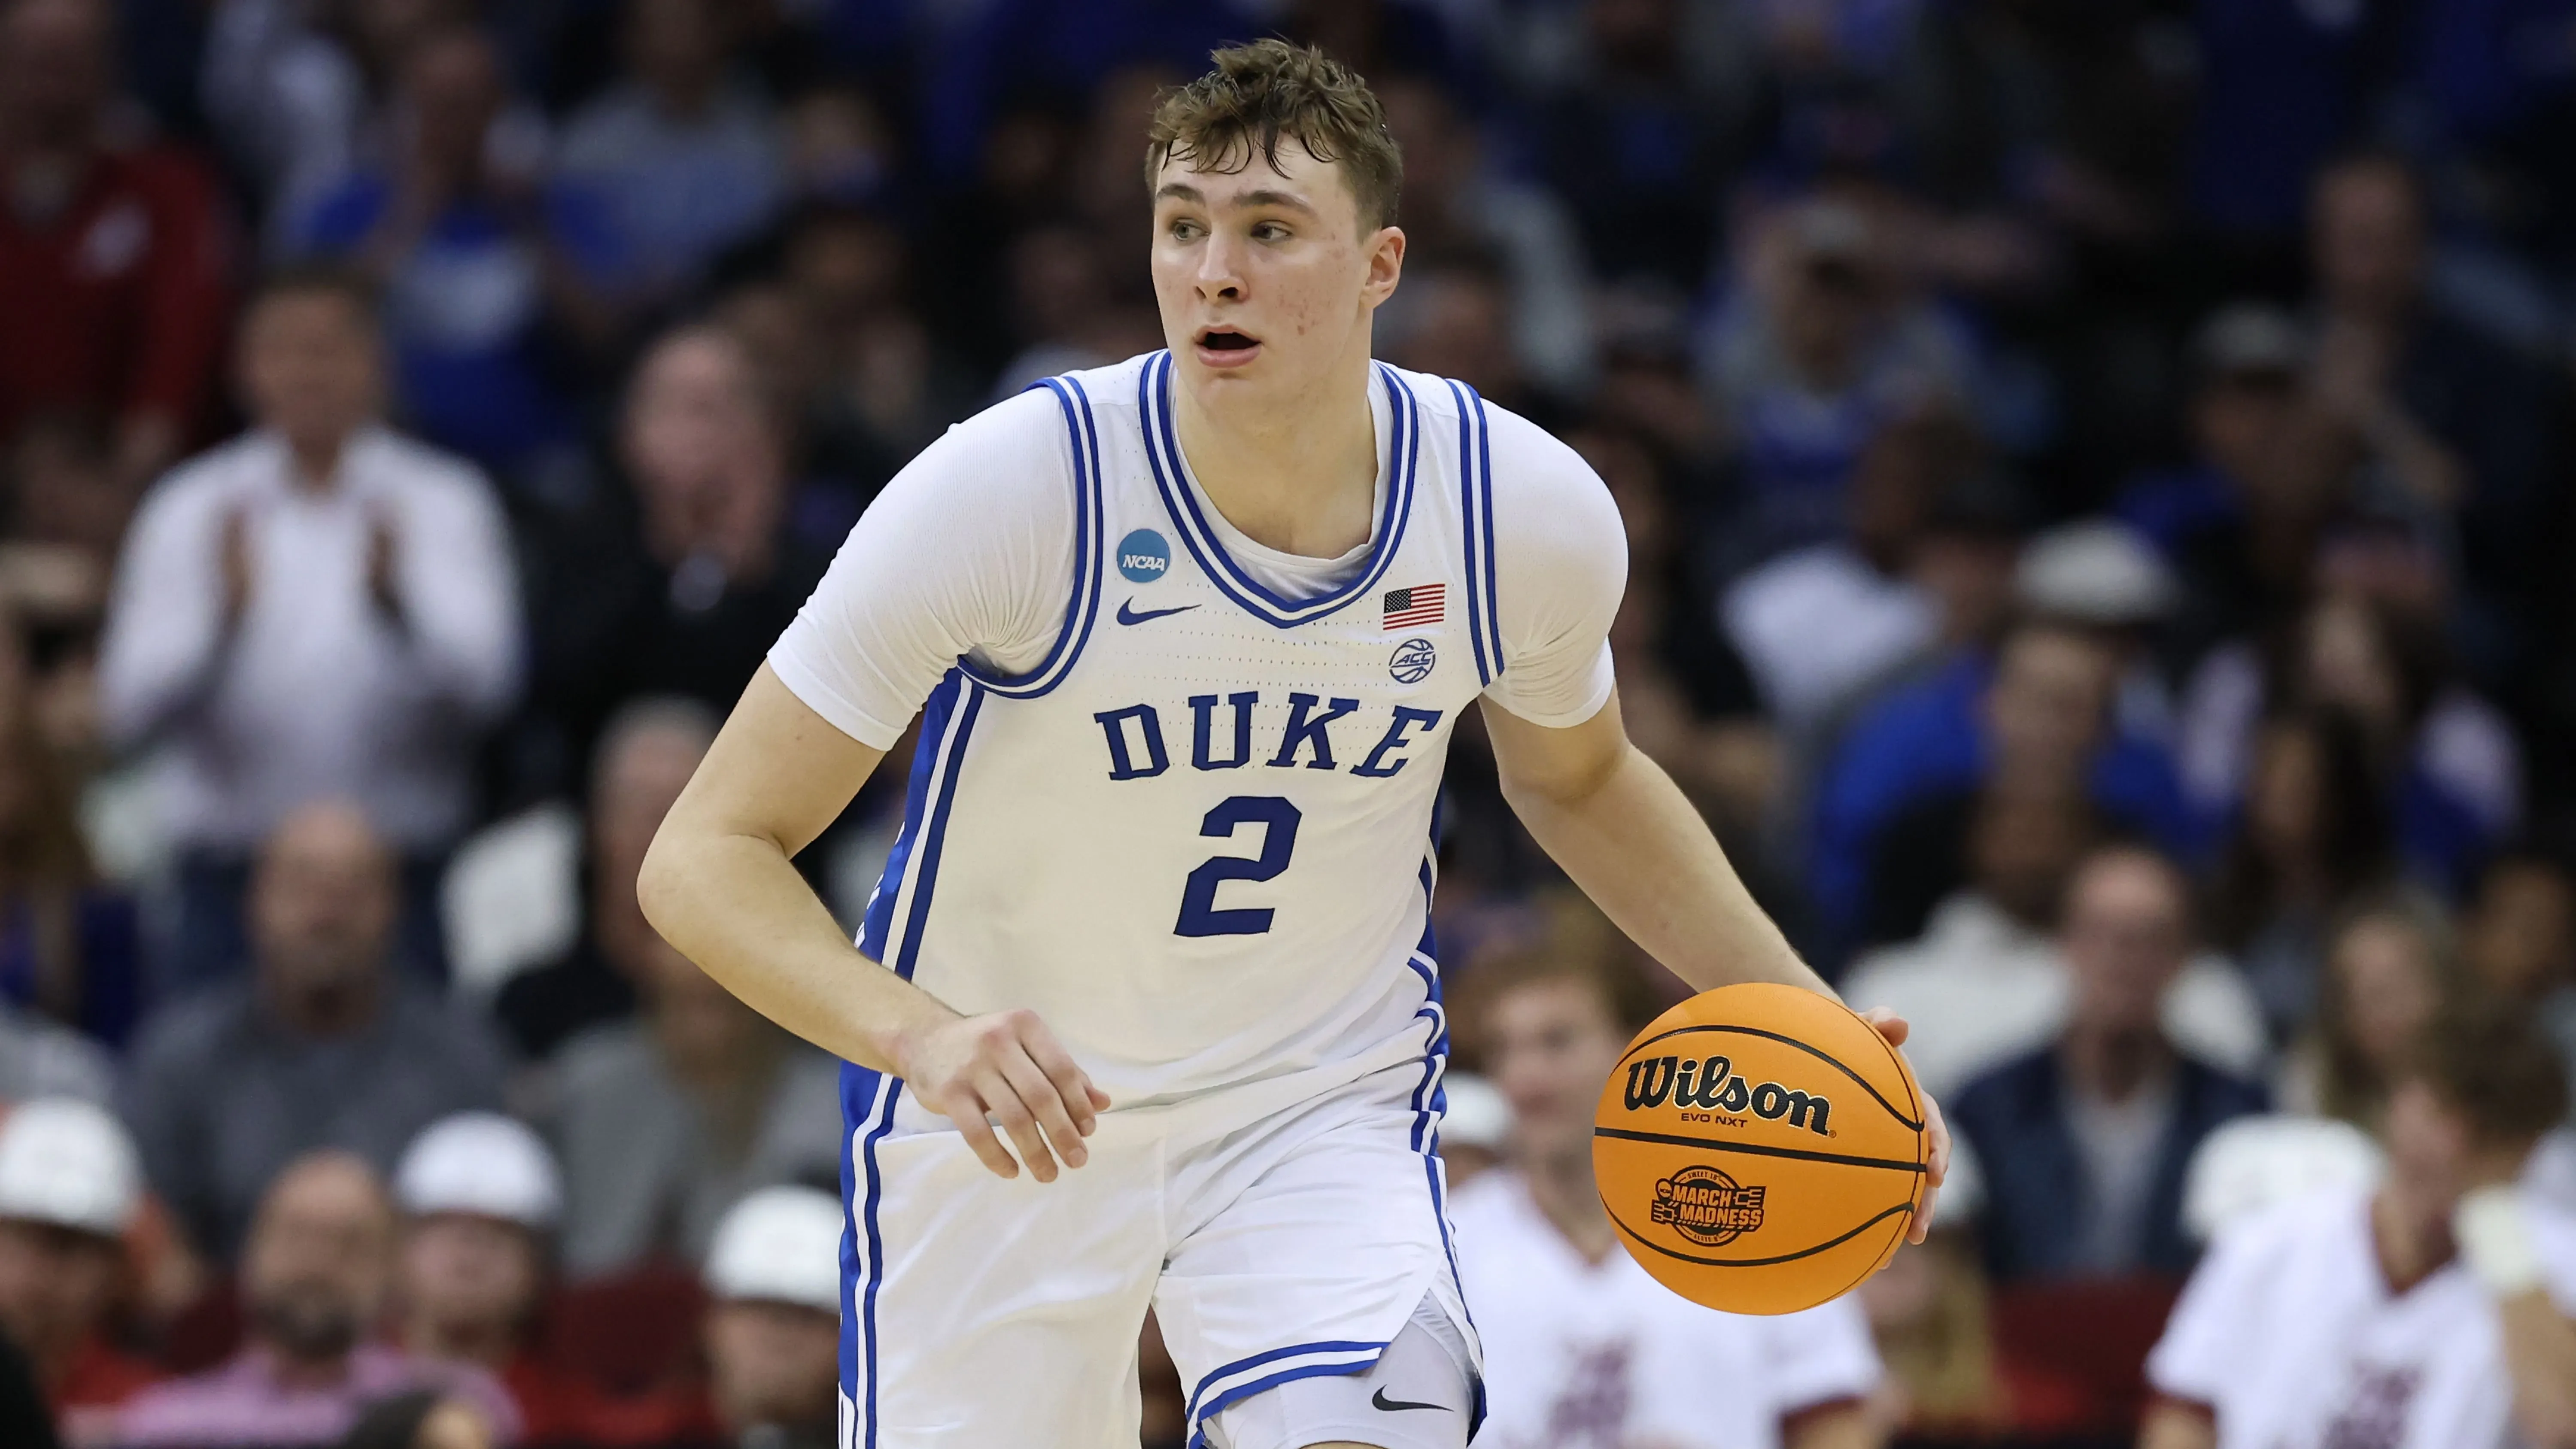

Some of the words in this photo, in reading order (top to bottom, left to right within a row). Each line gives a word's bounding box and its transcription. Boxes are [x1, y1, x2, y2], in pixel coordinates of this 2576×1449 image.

[1122, 554, 1165, 571] NCAA
[1394, 651, 1434, 665] ACC
[1093, 691, 1443, 781] DUKE
[1173, 796, 1302, 937] 2
[1623, 1055, 1829, 1137] Wilson
[1681, 1113, 1710, 1122] EVO
[1715, 1115, 1748, 1128] NXT
[1672, 1185, 1732, 1207] MARCH
[1680, 1203, 1762, 1226] MADNESS
